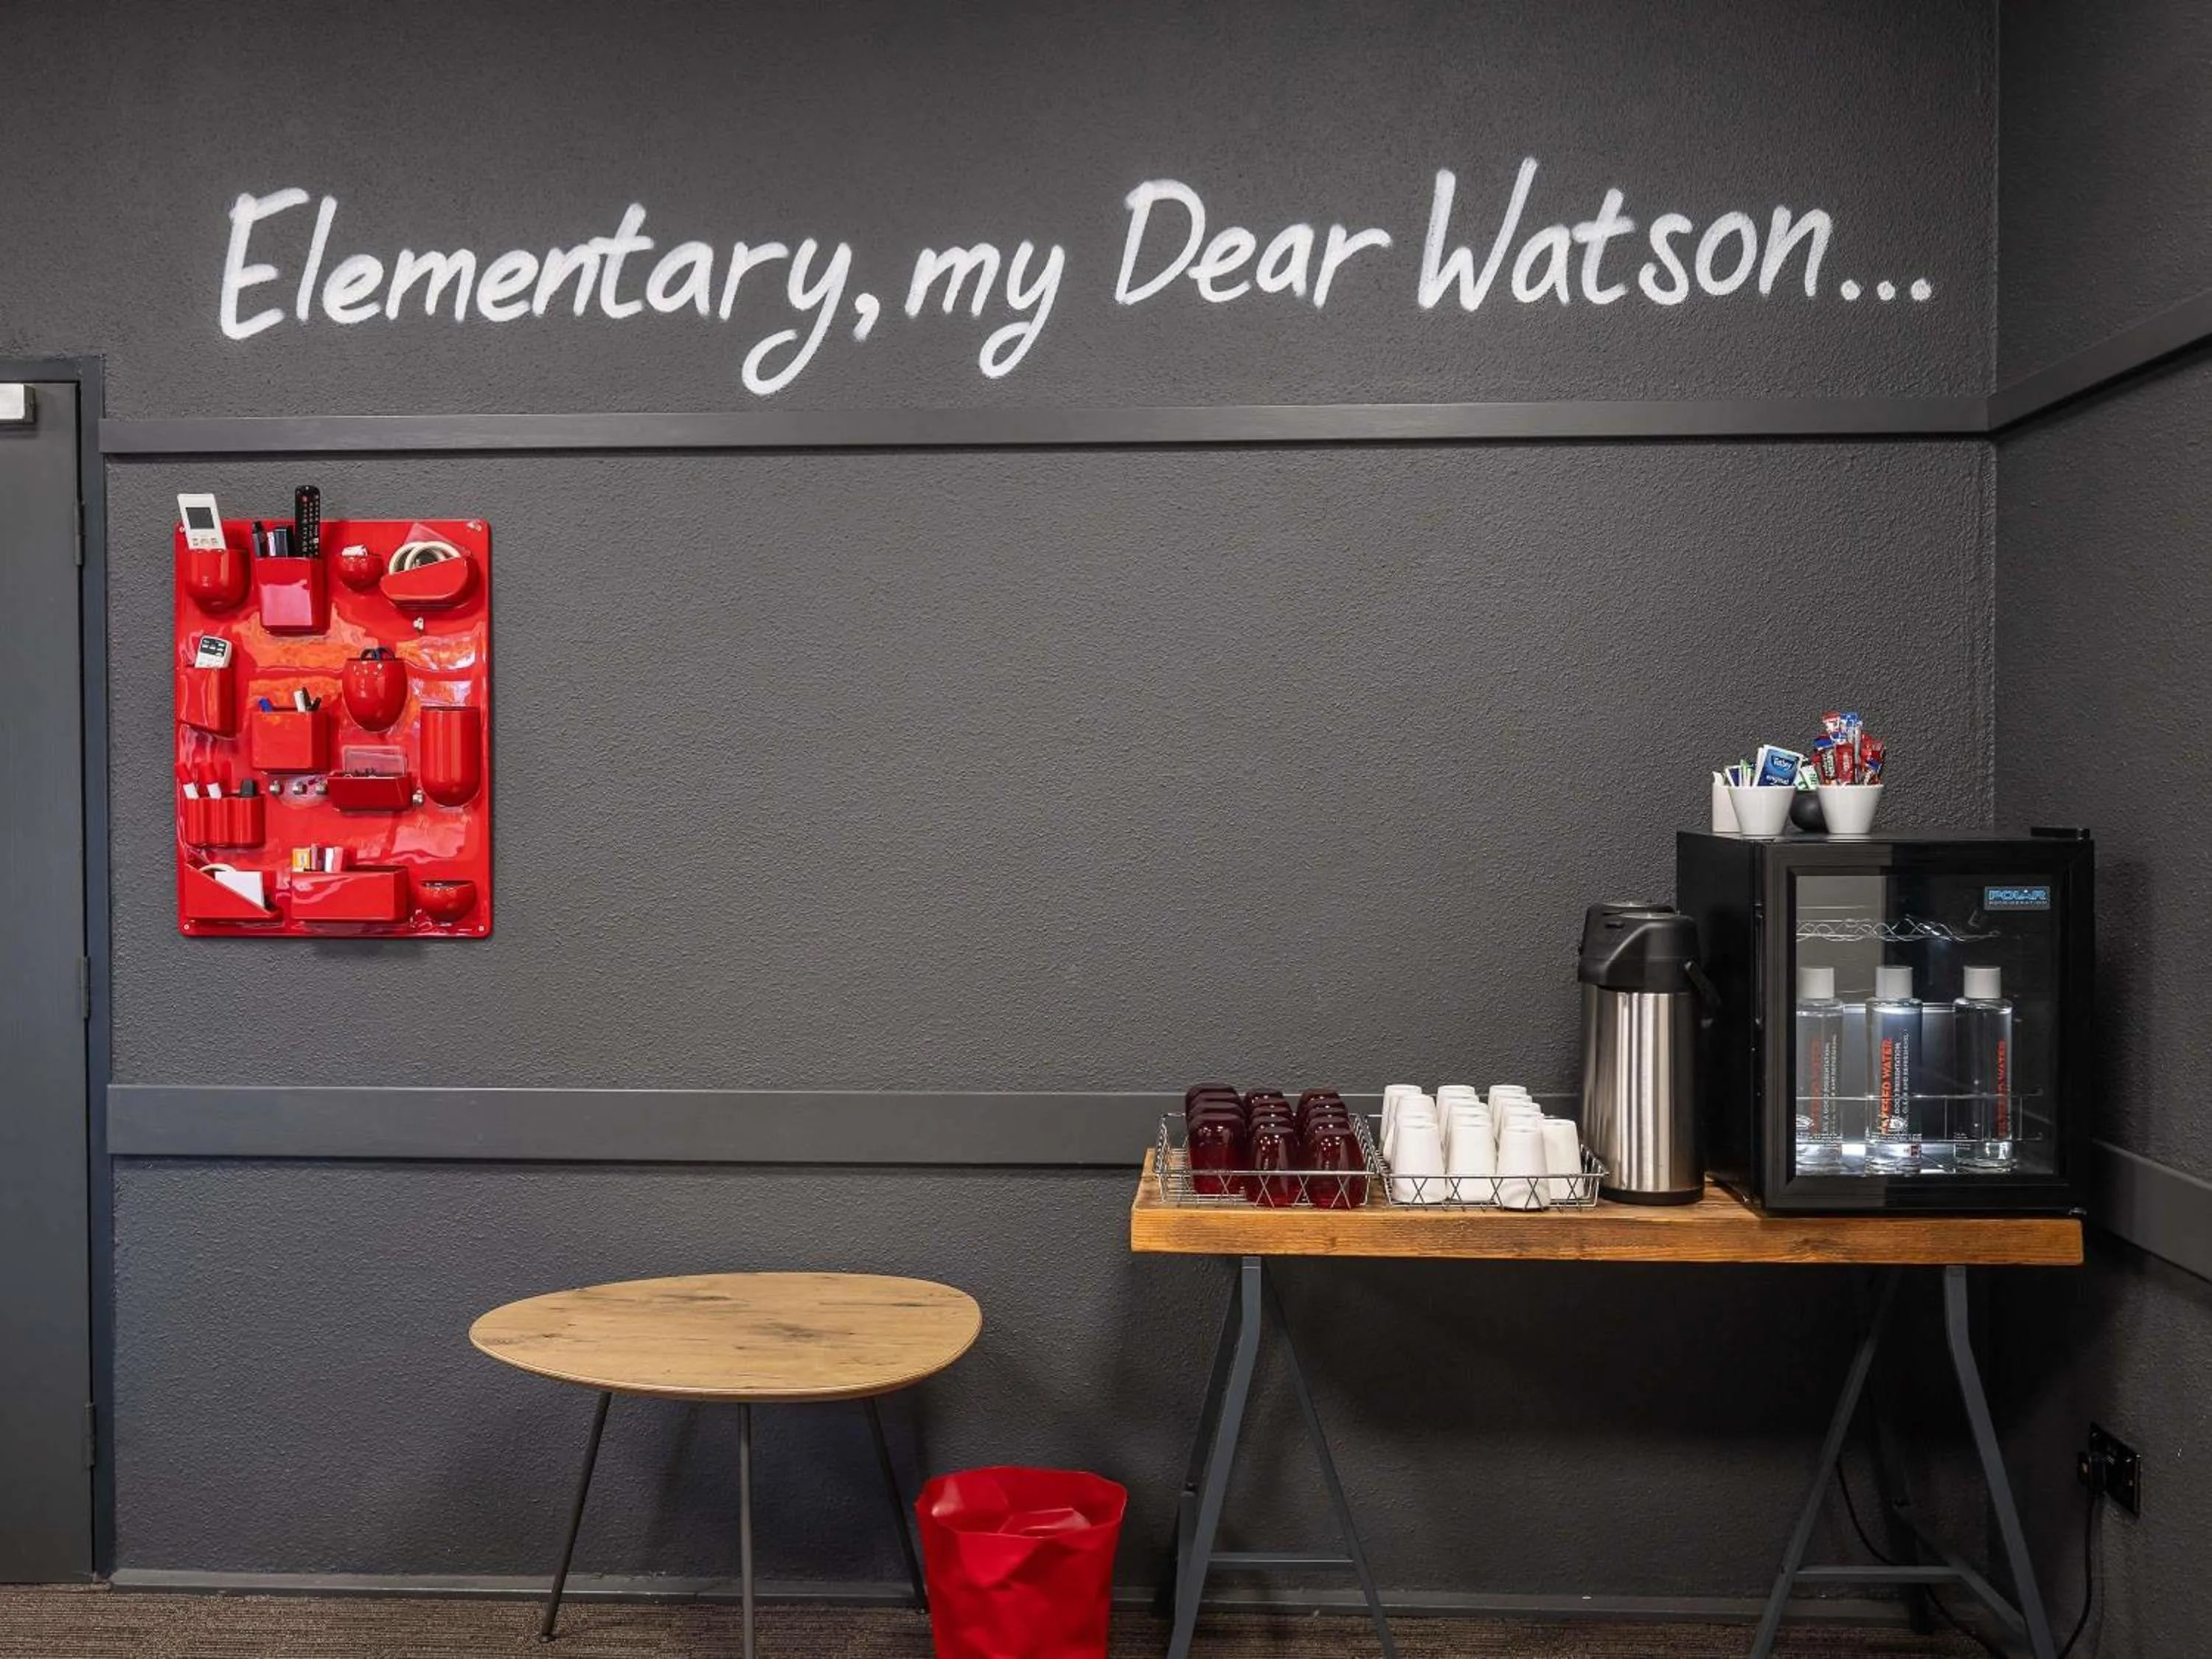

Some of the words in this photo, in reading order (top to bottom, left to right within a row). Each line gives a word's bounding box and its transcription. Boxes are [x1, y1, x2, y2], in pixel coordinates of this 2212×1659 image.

[219, 187, 881, 397] Elementary,
[903, 240, 1066, 380] my
[1113, 178, 1393, 310] Dear
[1416, 156, 1933, 313] Watson...
[1989, 889, 2048, 900] POLAR
[1879, 1037, 1892, 1079] WATER
